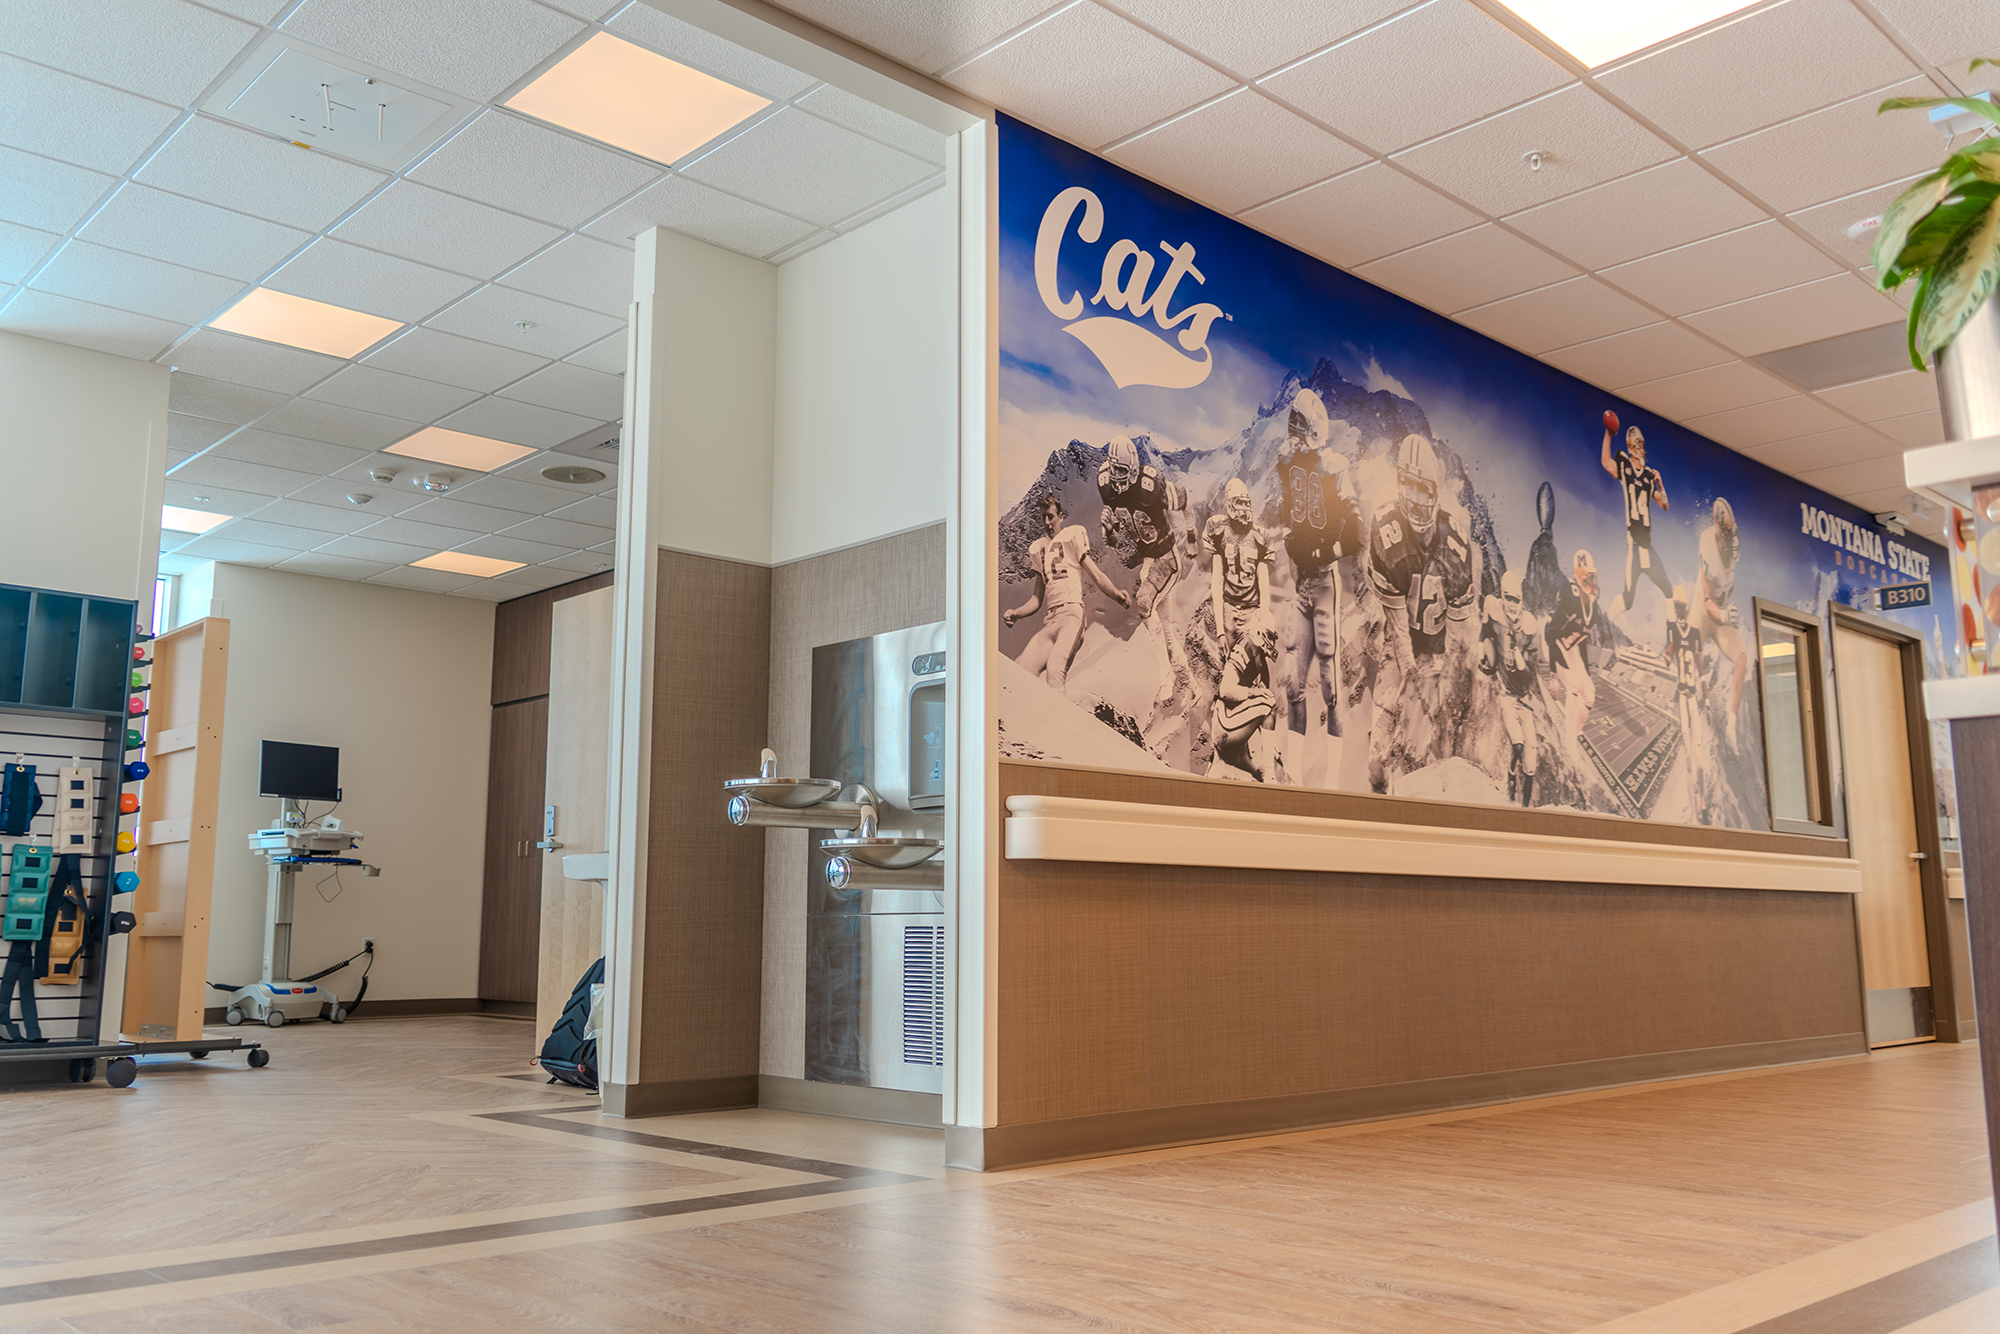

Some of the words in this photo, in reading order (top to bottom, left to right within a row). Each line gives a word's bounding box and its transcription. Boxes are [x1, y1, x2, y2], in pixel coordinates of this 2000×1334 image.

[1862, 219, 1878, 228] FIRE
[1034, 186, 1224, 351] Cats
[1039, 541, 1069, 586] 12
[1800, 502, 1886, 565] MONTANA
[1887, 540, 1931, 581] STATE
[1406, 573, 1447, 636] 12
[1887, 586, 1926, 605] B310
[1678, 647, 1696, 687] 13
[1623, 750, 1659, 793] STATE
